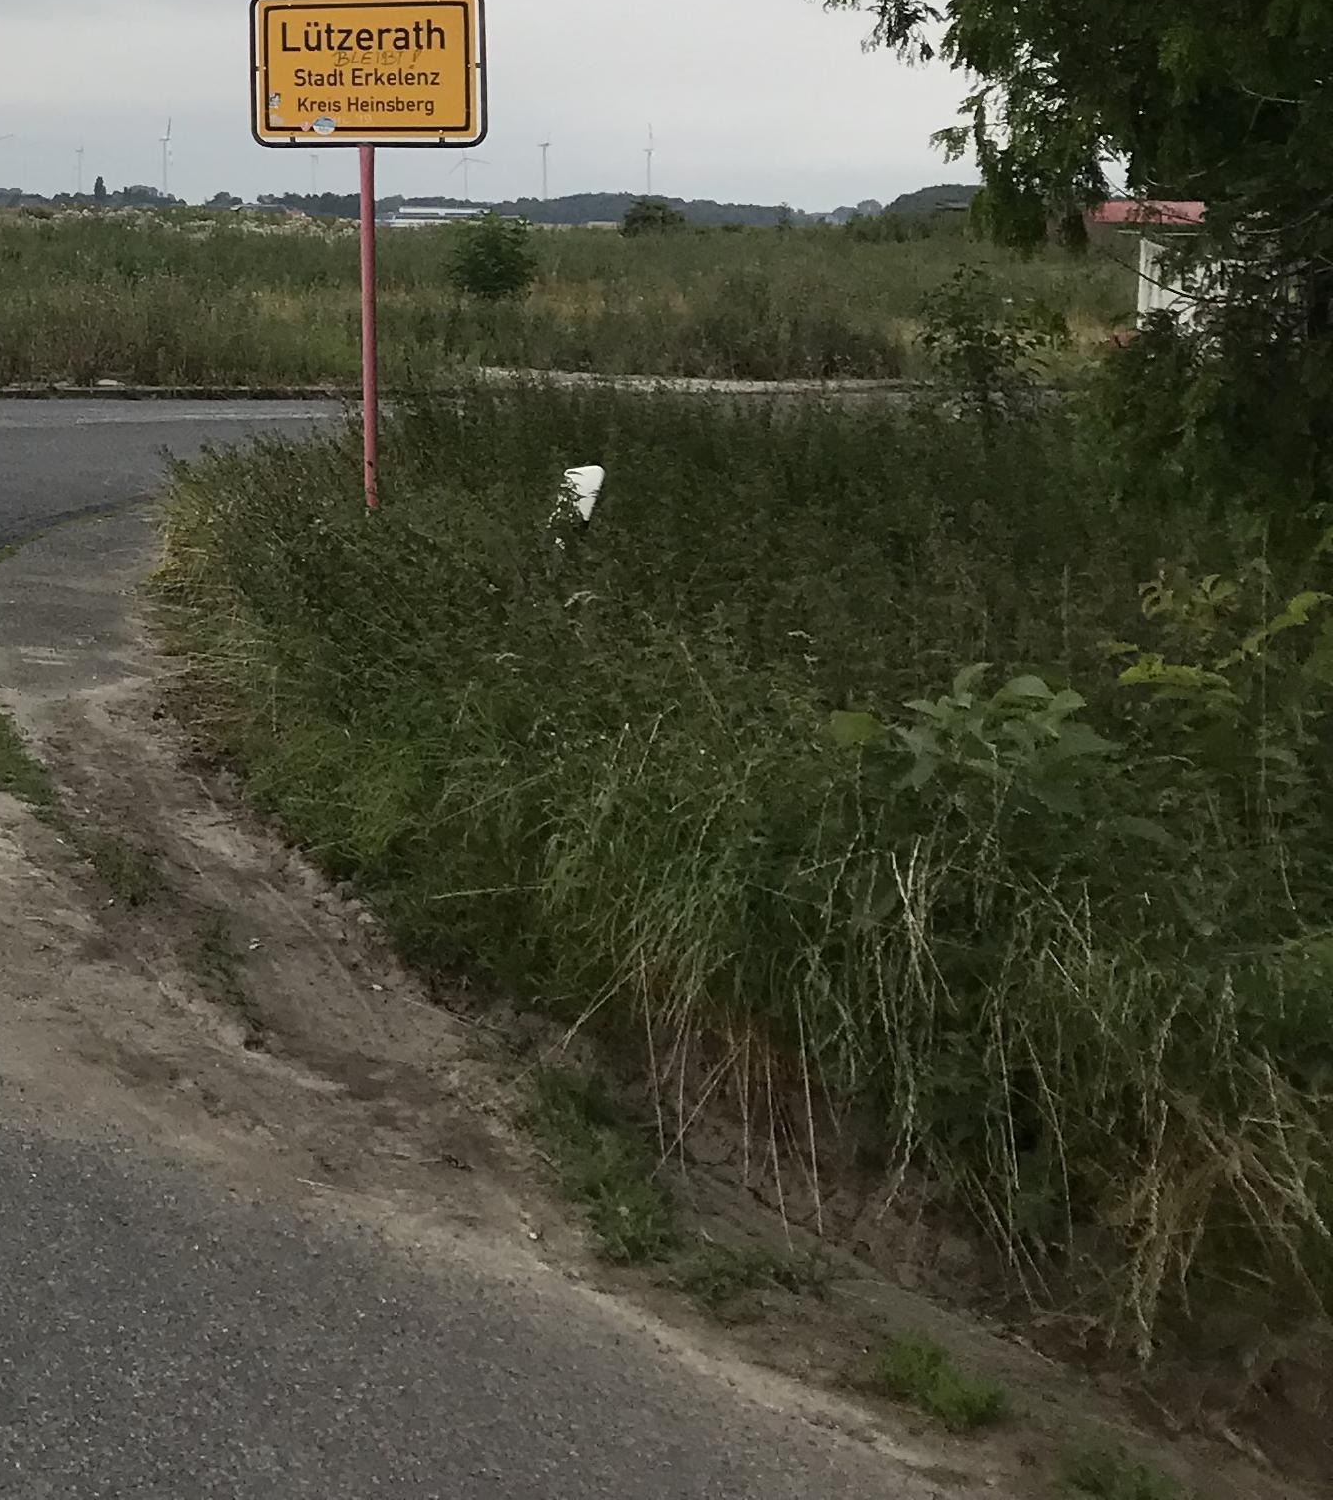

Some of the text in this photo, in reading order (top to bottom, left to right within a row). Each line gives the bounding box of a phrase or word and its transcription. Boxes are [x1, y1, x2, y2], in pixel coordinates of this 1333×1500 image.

[281, 19, 445, 52] Lützerath
[294, 68, 440, 87] Stadt Erkelenz
[297, 96, 434, 116] Kreis Heinsberg
